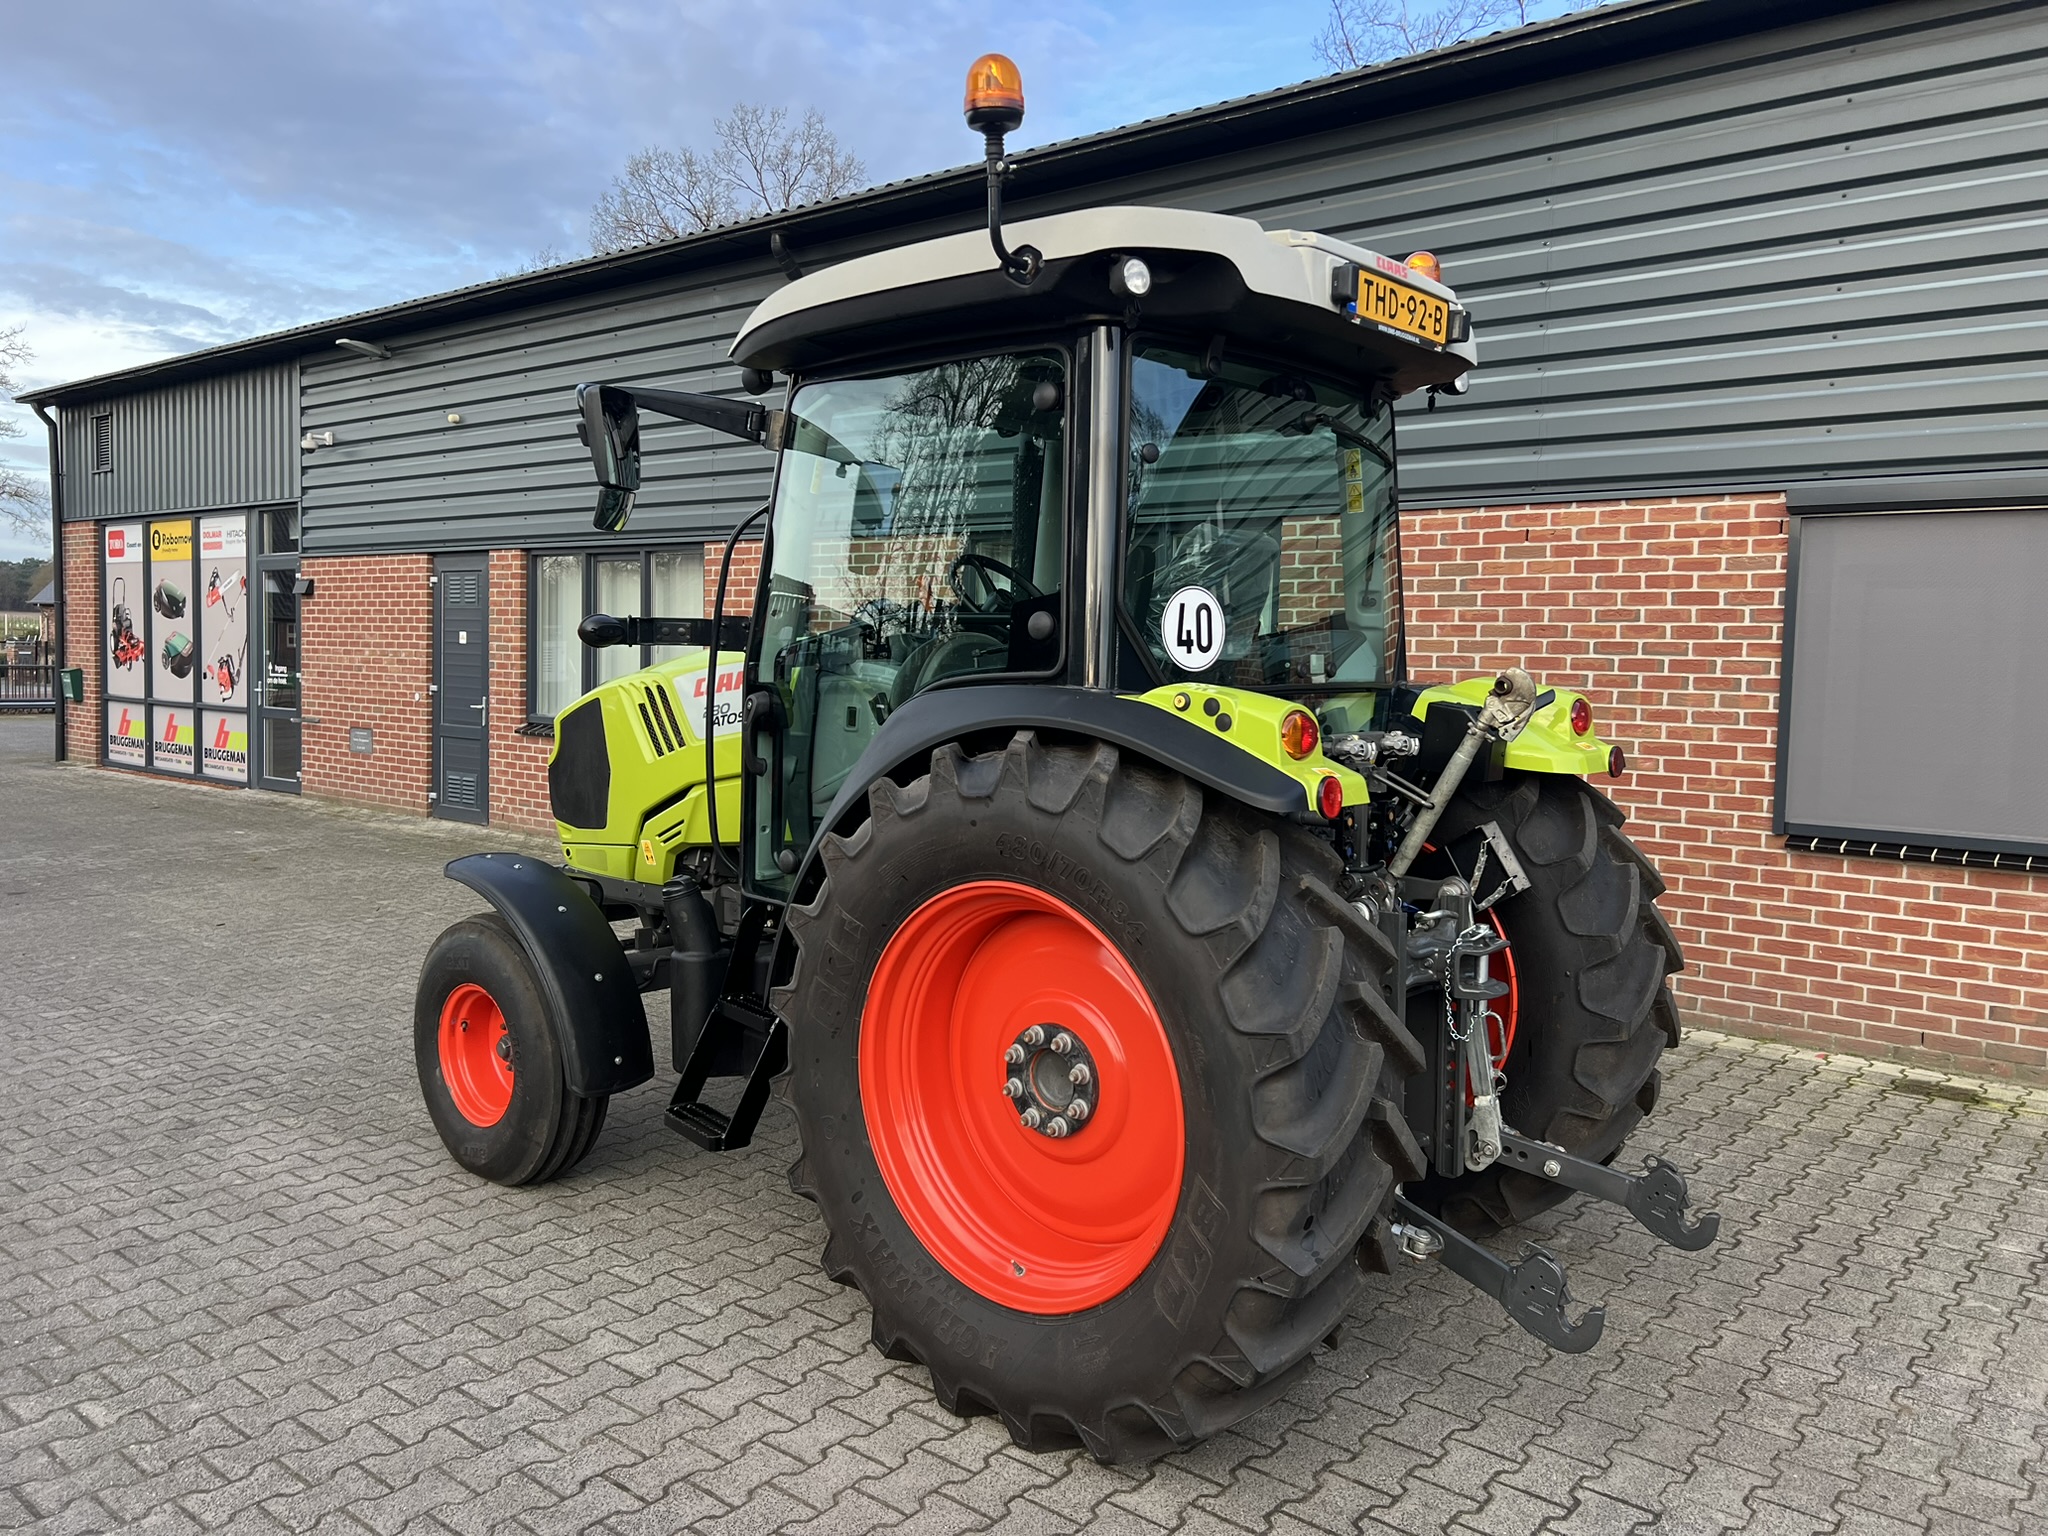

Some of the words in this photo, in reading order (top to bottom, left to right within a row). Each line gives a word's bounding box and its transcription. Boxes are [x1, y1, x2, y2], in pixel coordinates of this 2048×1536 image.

[1376, 255, 1408, 279] CLAAS
[1364, 277, 1443, 336] THD-92-B
[1177, 603, 1213, 654] 40
[693, 671, 744, 698] CAA
[109, 734, 145, 750] BRUGGEMAN
[155, 741, 193, 757] BRUGGEMAN
[204, 747, 246, 764] BRUGGEMAN
